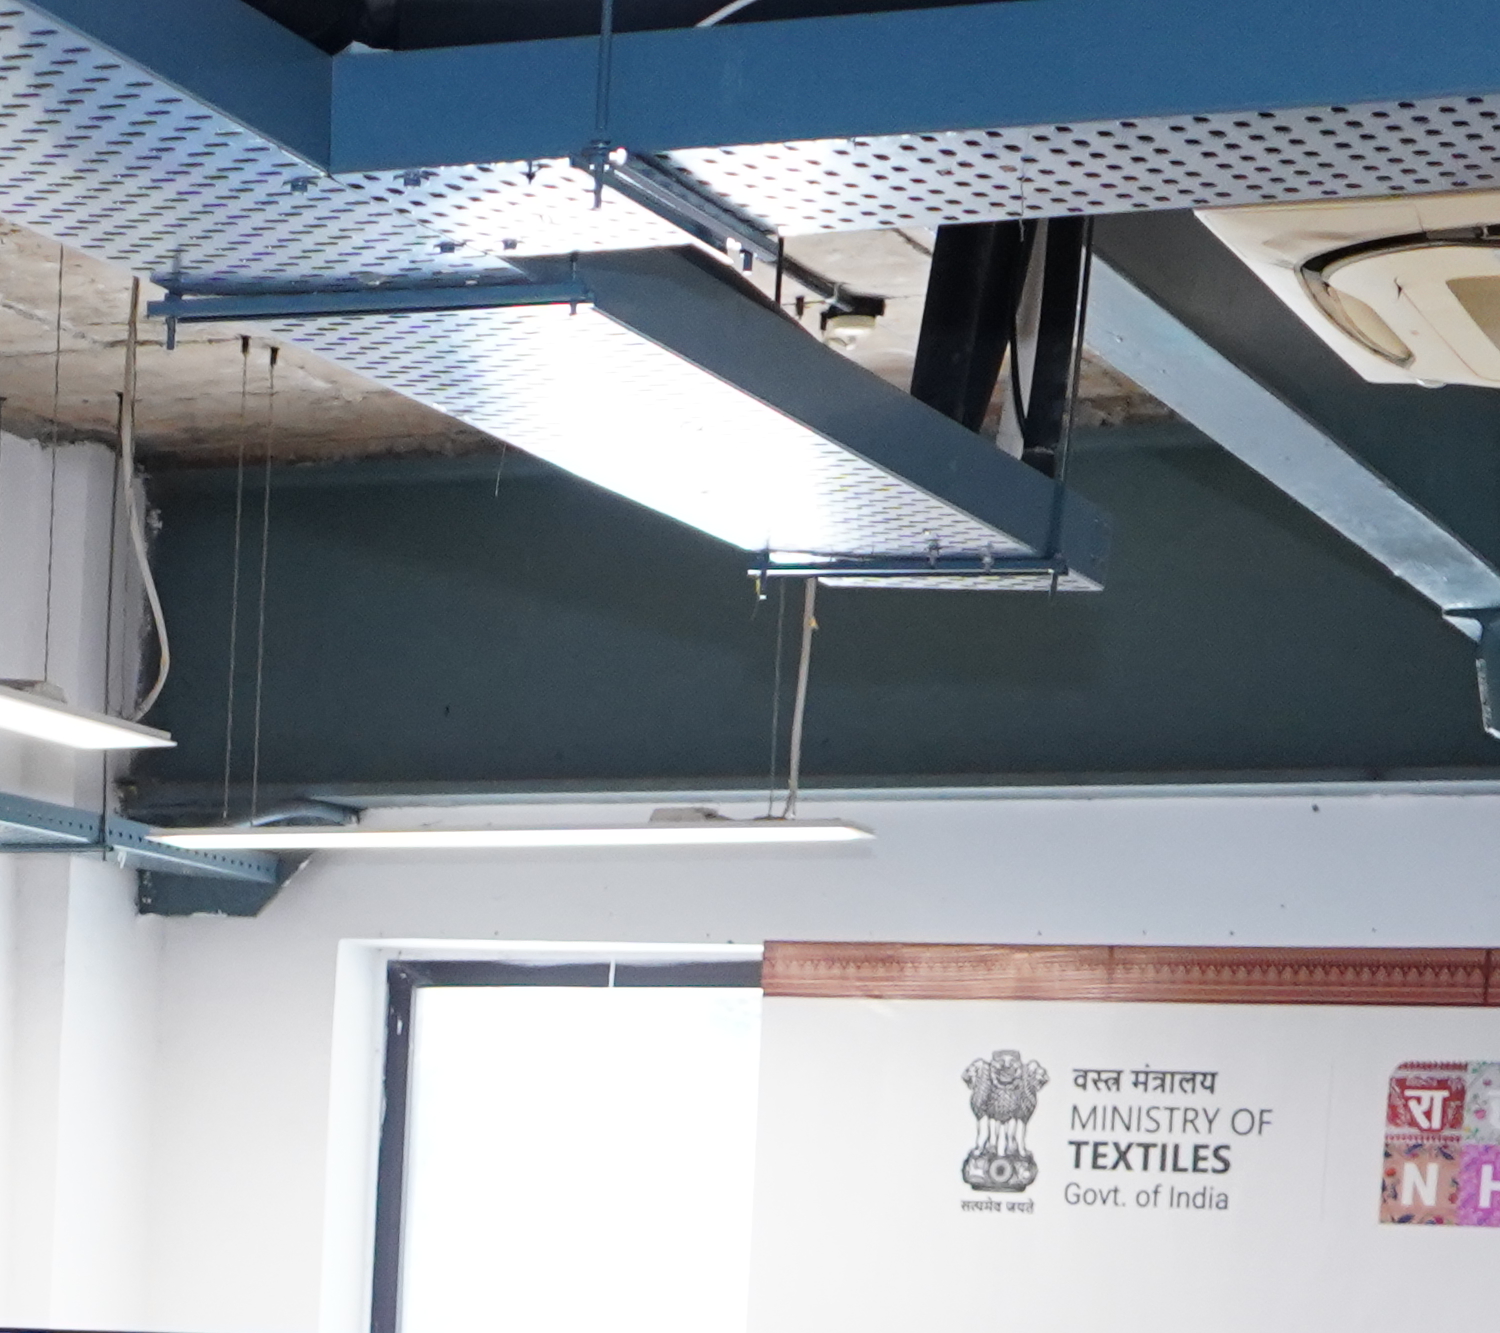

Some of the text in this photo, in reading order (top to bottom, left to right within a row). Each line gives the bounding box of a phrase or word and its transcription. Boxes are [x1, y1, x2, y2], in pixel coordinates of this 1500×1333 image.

[1072, 1063, 1219, 1094] वस्त्र मंत्रालय
[1070, 1104, 1273, 1136] MINISTRY OF
[1068, 1140, 1231, 1174] TEXTILES
[1064, 1182, 1229, 1210] Govt. of India
